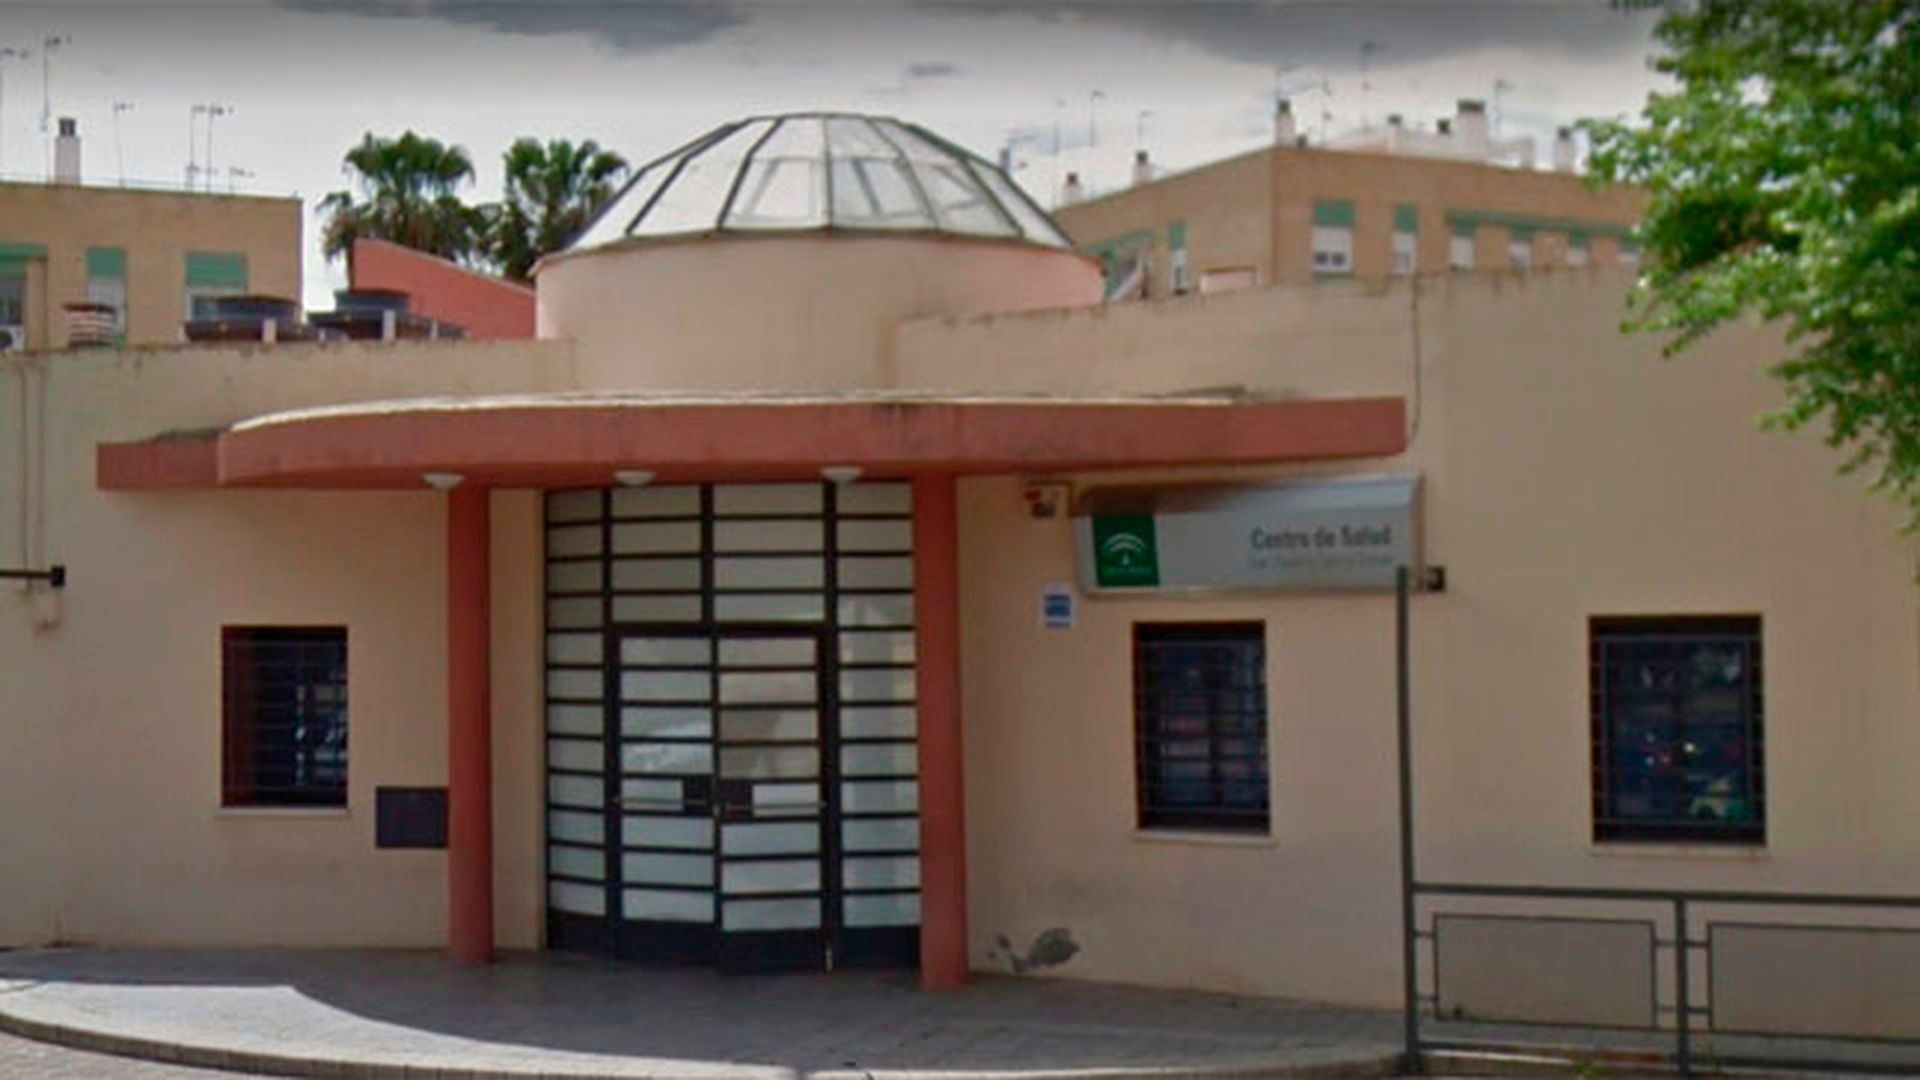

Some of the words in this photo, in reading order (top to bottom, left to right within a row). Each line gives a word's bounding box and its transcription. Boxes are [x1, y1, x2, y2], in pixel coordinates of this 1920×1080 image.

[1250, 526, 1309, 548] Centro
[1314, 525, 1335, 547] de
[1340, 524, 1391, 546] Salud
